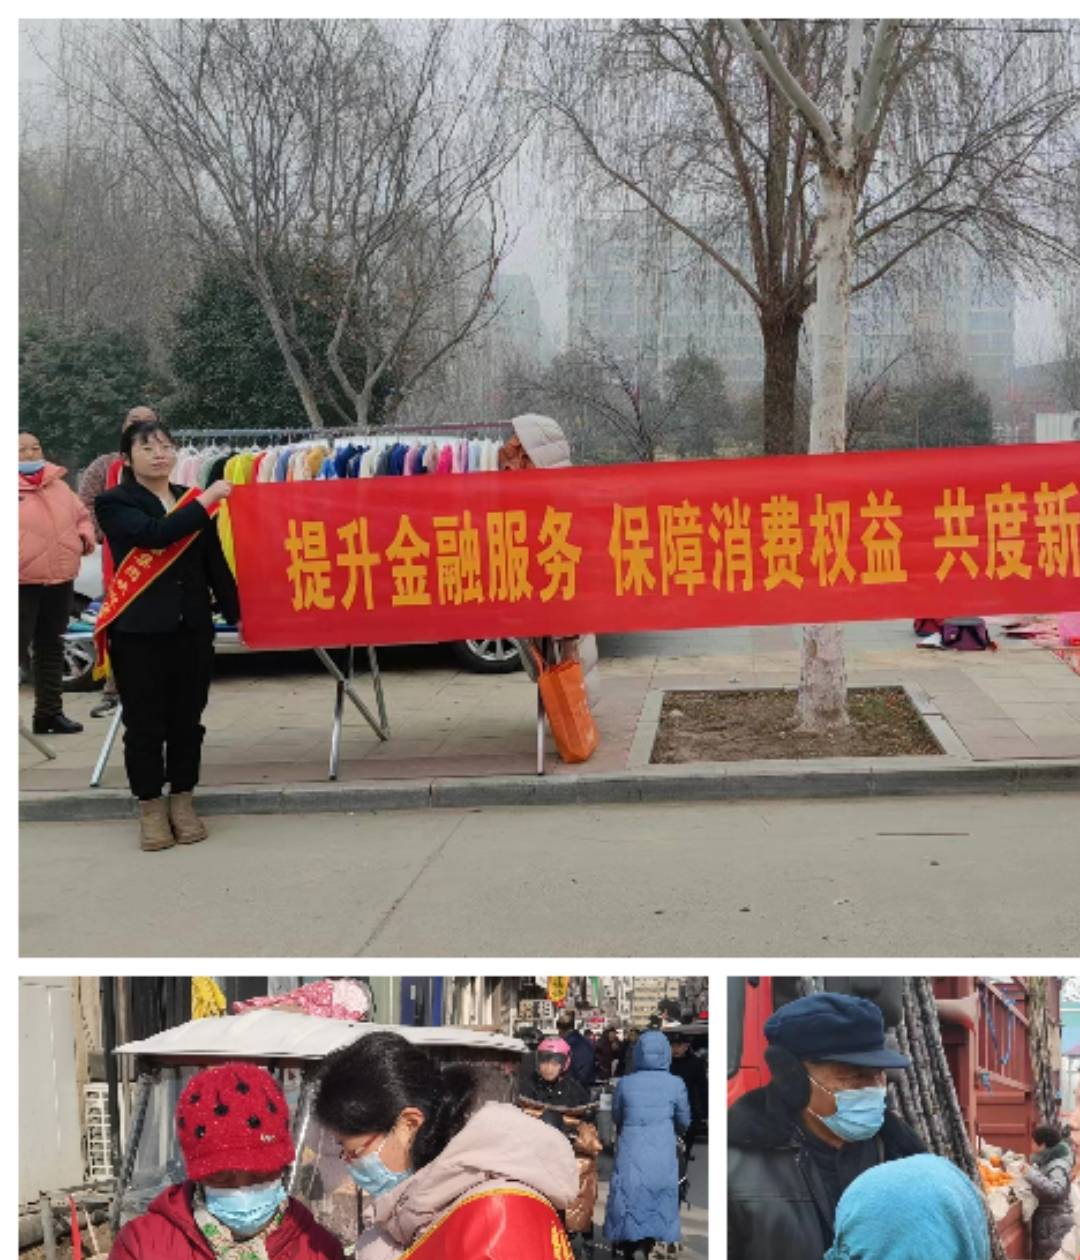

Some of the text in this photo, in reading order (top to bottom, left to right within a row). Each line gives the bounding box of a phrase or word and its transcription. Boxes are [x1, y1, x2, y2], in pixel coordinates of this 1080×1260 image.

[285, 505, 582, 610] 提升金融服务
[608, 490, 907, 597] 保障消费权益
